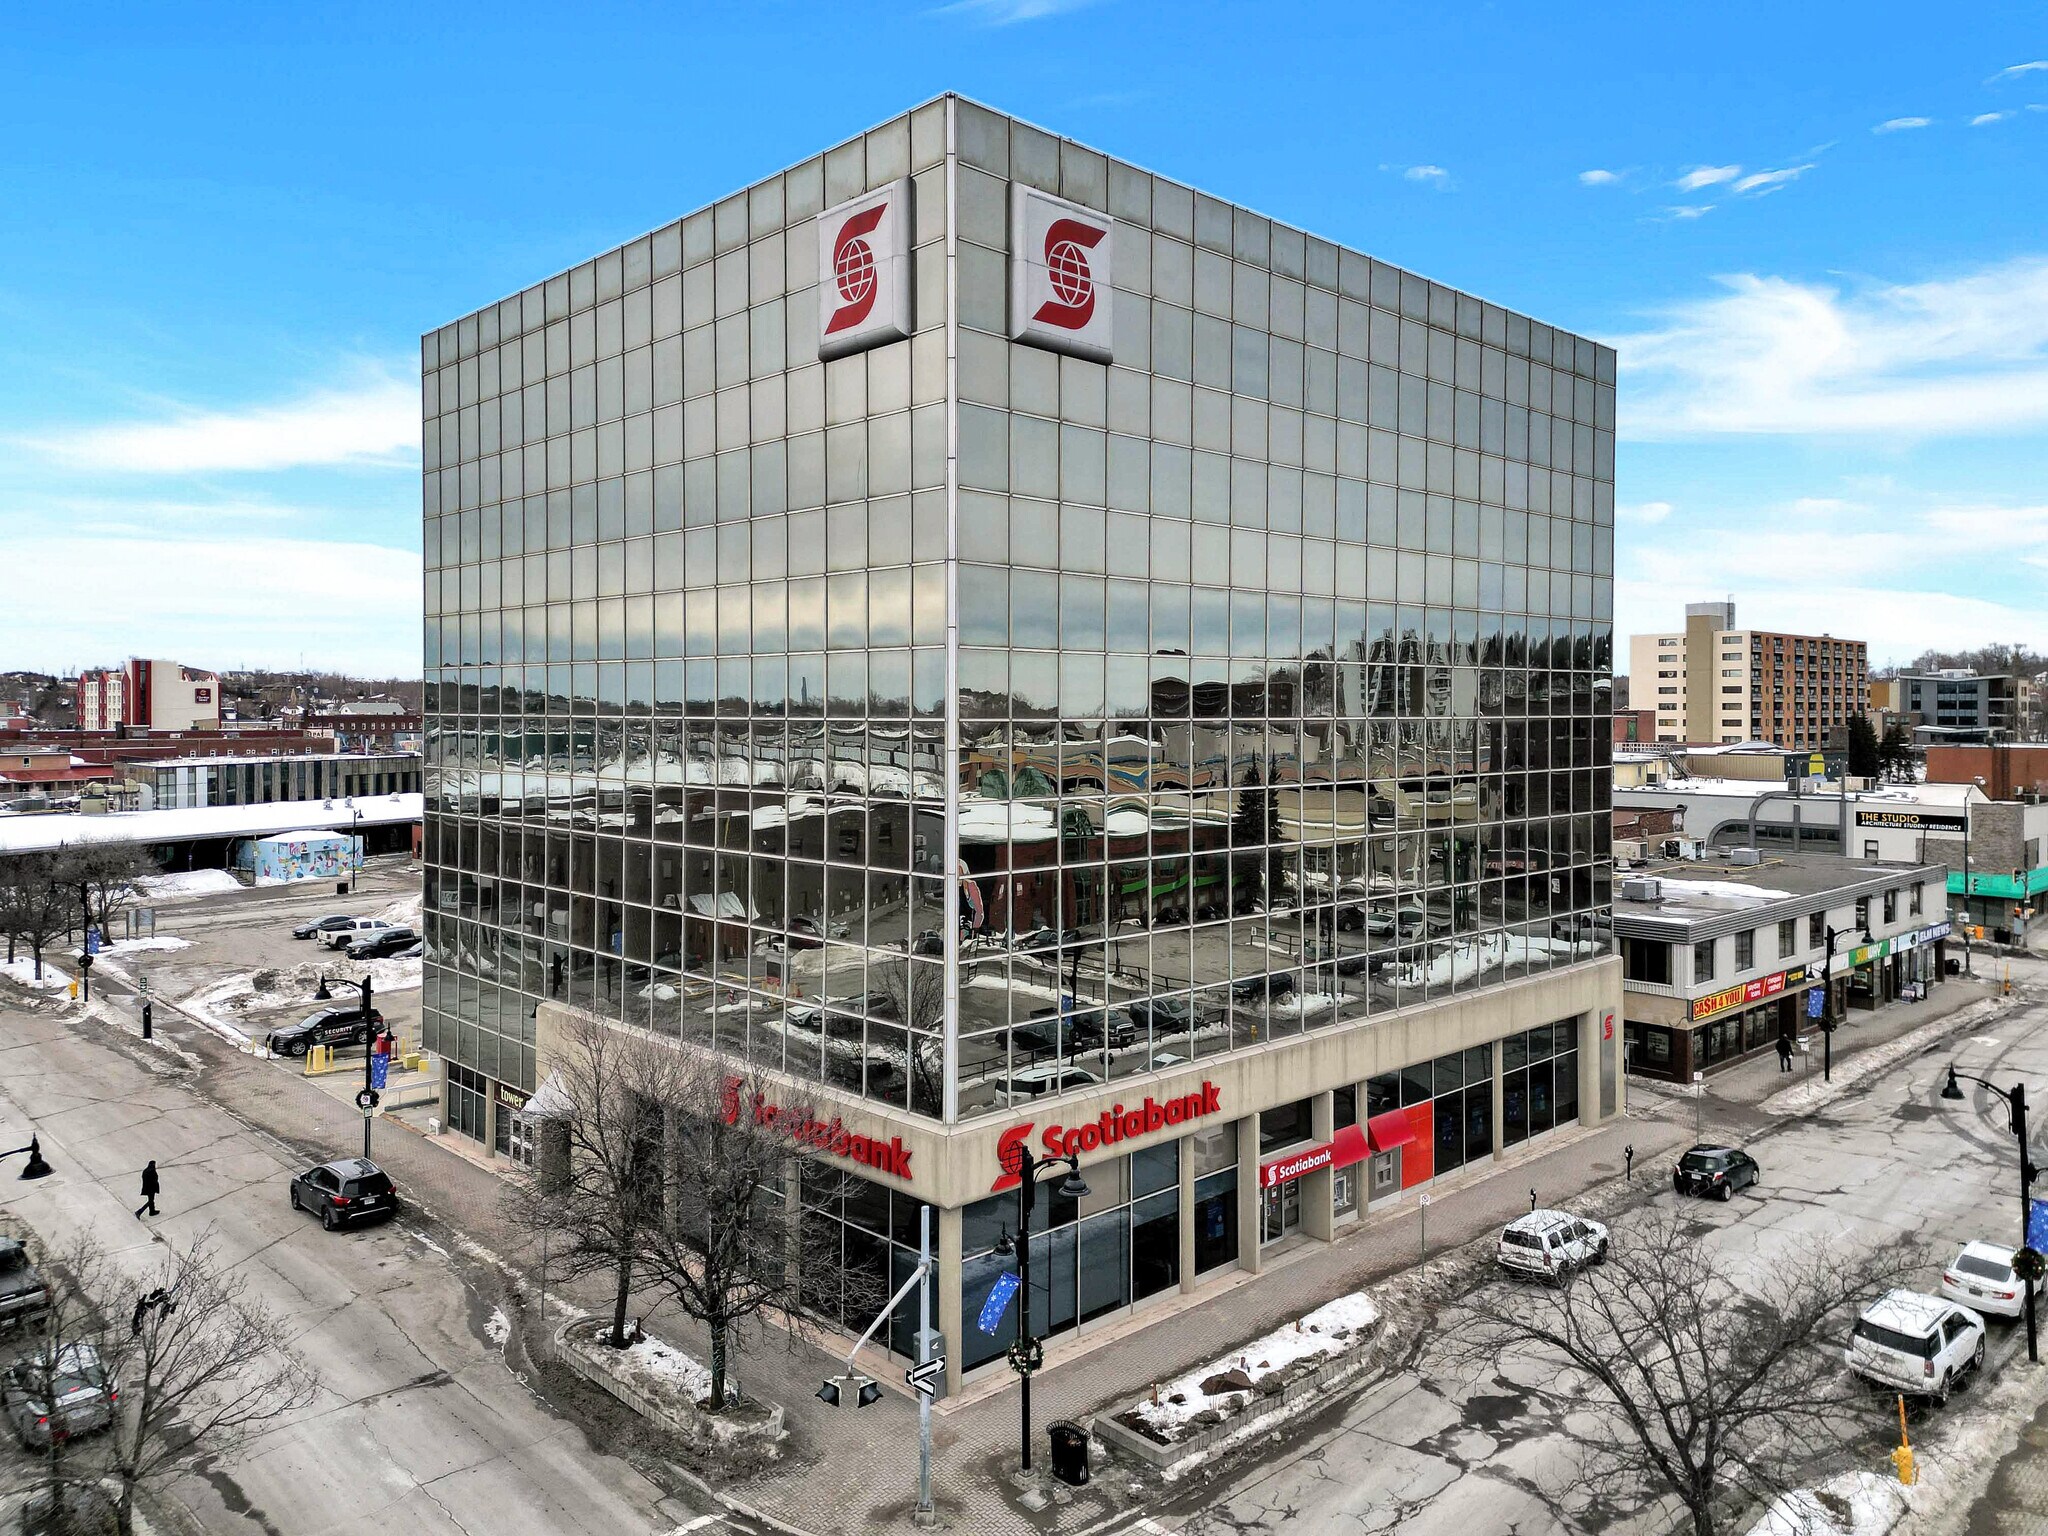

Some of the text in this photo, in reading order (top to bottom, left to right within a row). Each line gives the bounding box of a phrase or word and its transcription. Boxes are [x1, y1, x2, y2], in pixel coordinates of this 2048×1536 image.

[1861, 812, 1920, 823] THE STUDIO
[1861, 820, 1902, 828] ARCHITECTURE
[1933, 924, 1951, 938] NEWS
[1694, 990, 1740, 1016] CA$H 4 YOU
[324, 1026, 353, 1036] SECURITY
[500, 1085, 524, 1108] tower
[1041, 1080, 1222, 1160] Scotiabank
[1279, 1150, 1332, 1179] Scotiabank
